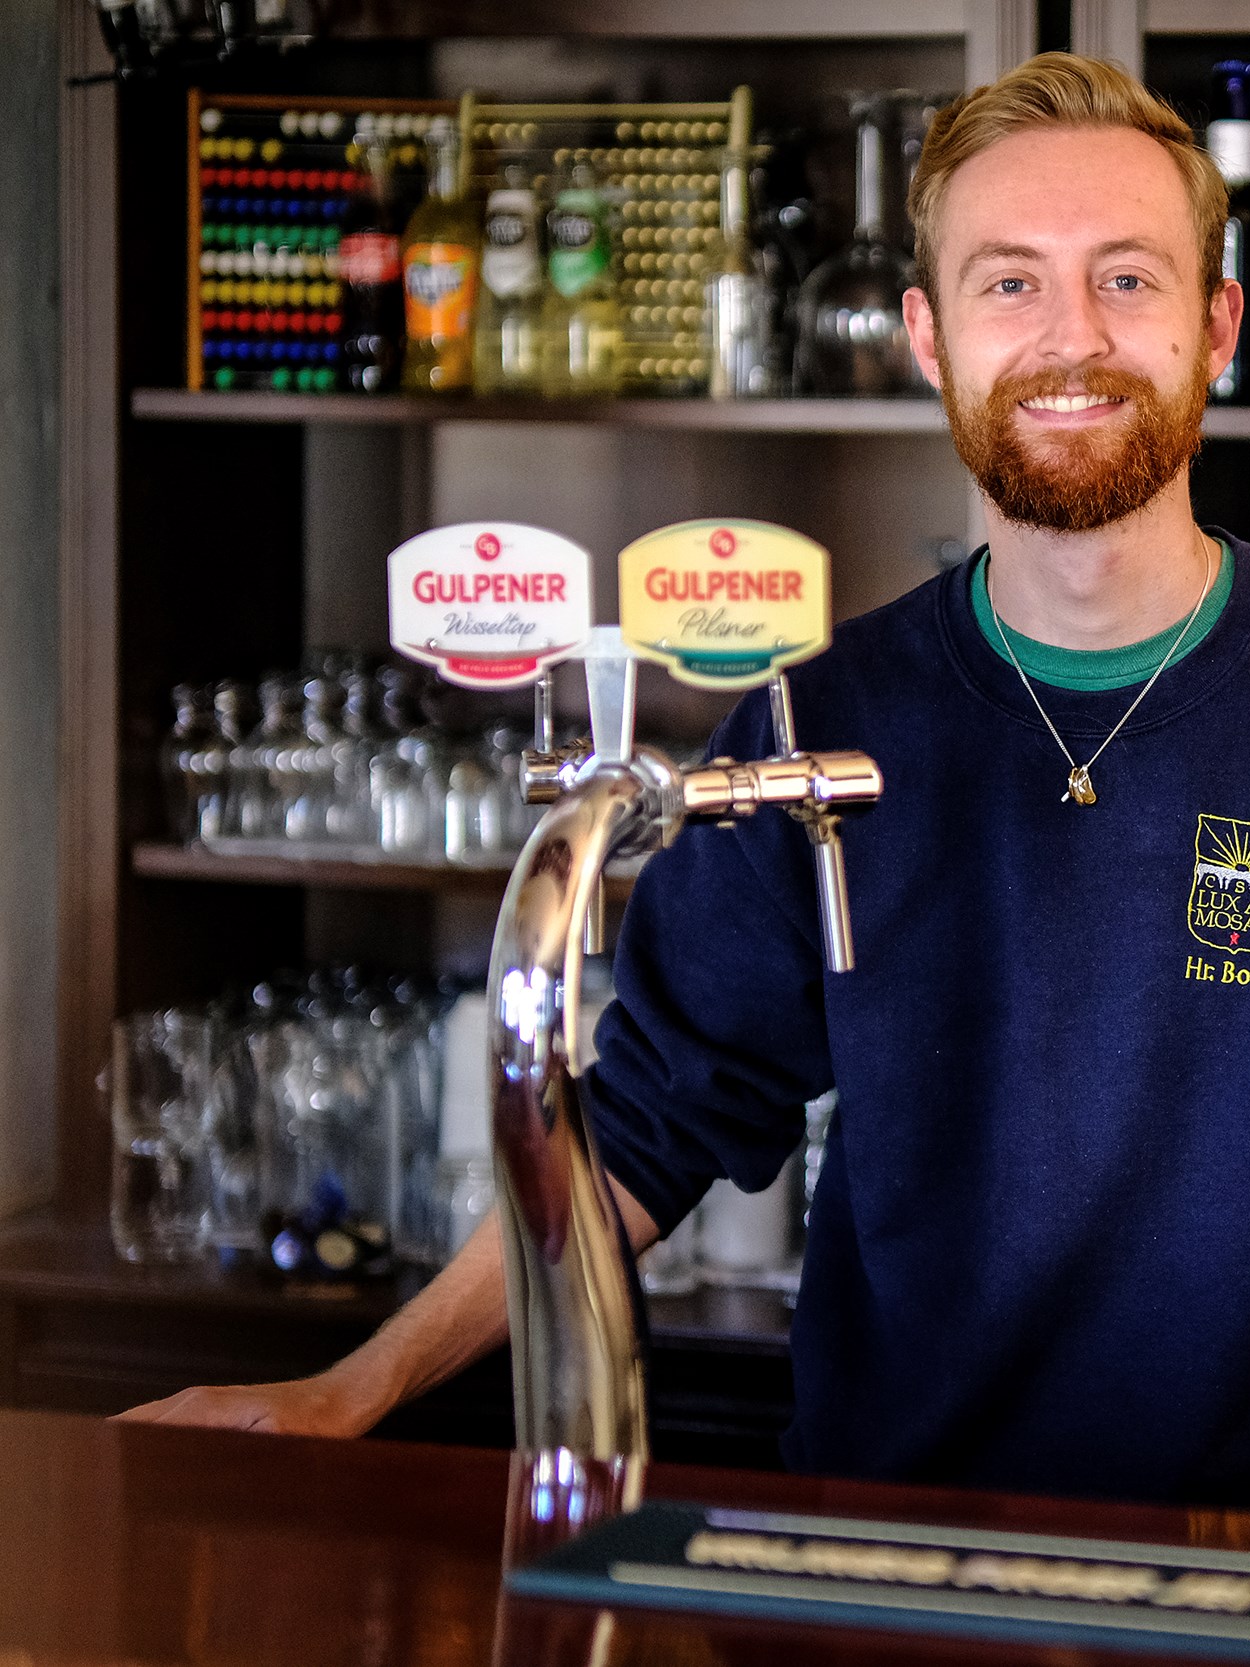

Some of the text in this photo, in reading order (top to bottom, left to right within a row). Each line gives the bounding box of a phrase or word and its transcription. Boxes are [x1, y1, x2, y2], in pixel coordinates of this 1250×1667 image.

[413, 570, 567, 604] GULPENER
[645, 567, 804, 602] GULPENER
[444, 611, 537, 649] Wisseltap
[678, 607, 767, 639] Pilsner
[1204, 875, 1216, 888] C
[1235, 880, 1246, 893] S
[1196, 889, 1241, 913] LUX
[1185, 956, 1215, 982] Hr.
